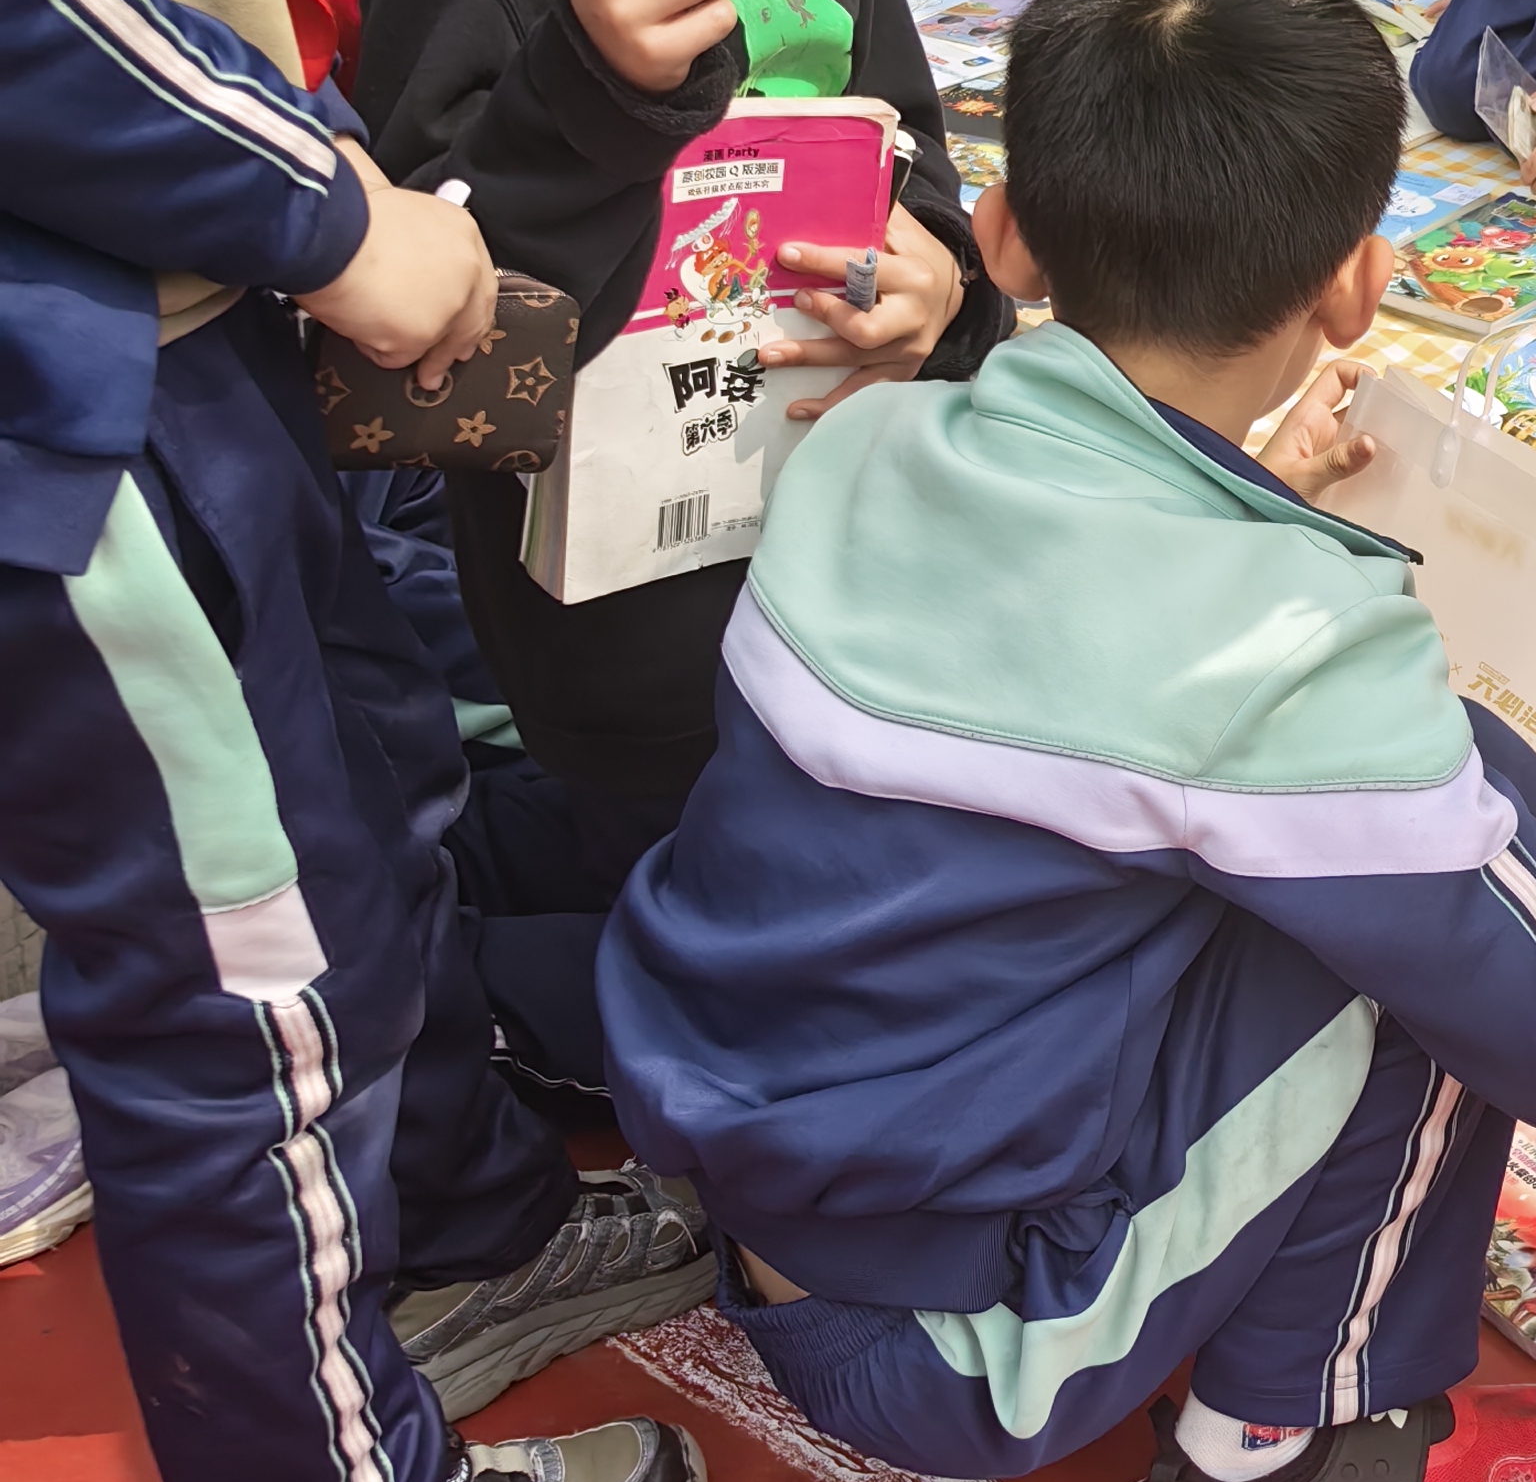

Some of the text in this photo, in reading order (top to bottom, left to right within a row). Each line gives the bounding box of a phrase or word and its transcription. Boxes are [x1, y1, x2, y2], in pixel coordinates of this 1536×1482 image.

[727, 146, 760, 158] Party
[681, 166, 727, 184] 原创校园
[665, 350, 767, 412] 阿衰
[684, 409, 734, 451] 第六季
